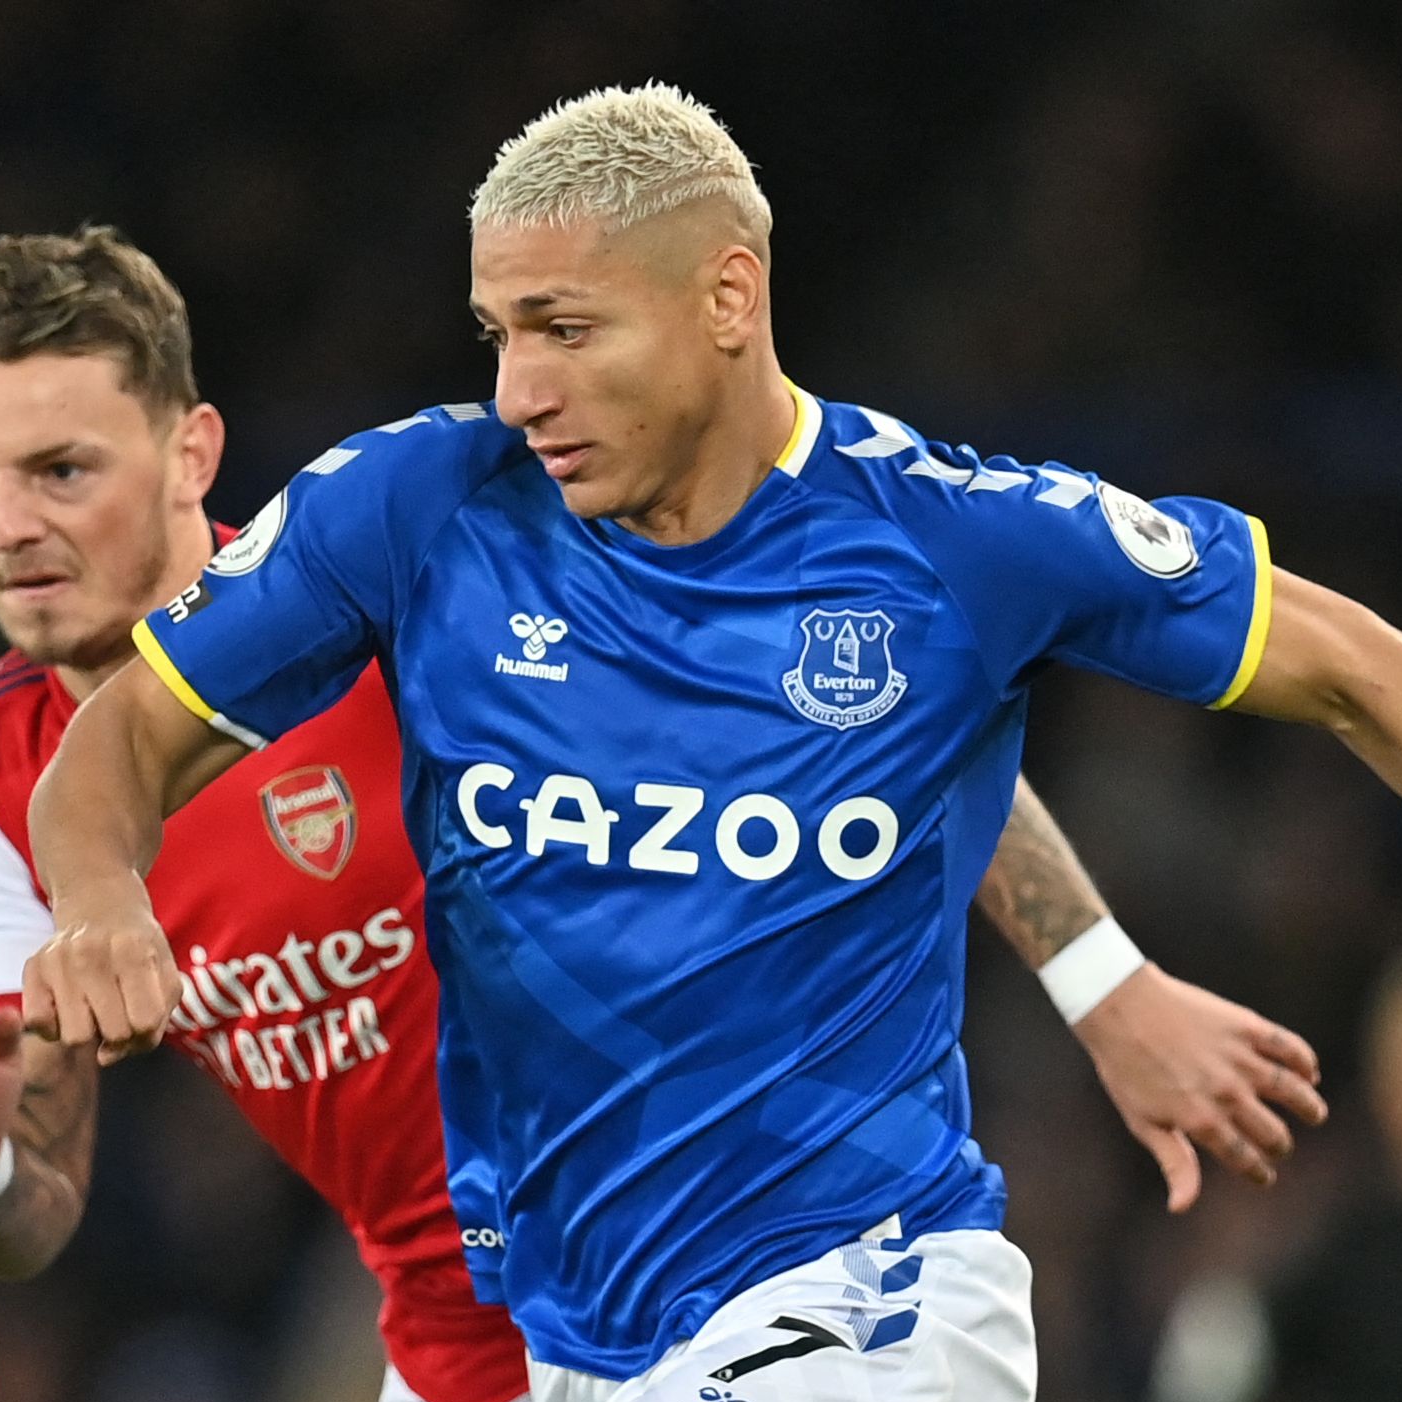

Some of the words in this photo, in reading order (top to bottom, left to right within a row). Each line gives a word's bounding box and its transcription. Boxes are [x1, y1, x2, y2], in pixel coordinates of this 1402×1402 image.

[495, 653, 569, 682] hummel
[813, 672, 876, 691] Everton
[457, 762, 900, 881] CAZOO
[233, 996, 391, 1090] BETTER
[705, 1314, 854, 1384] 7
